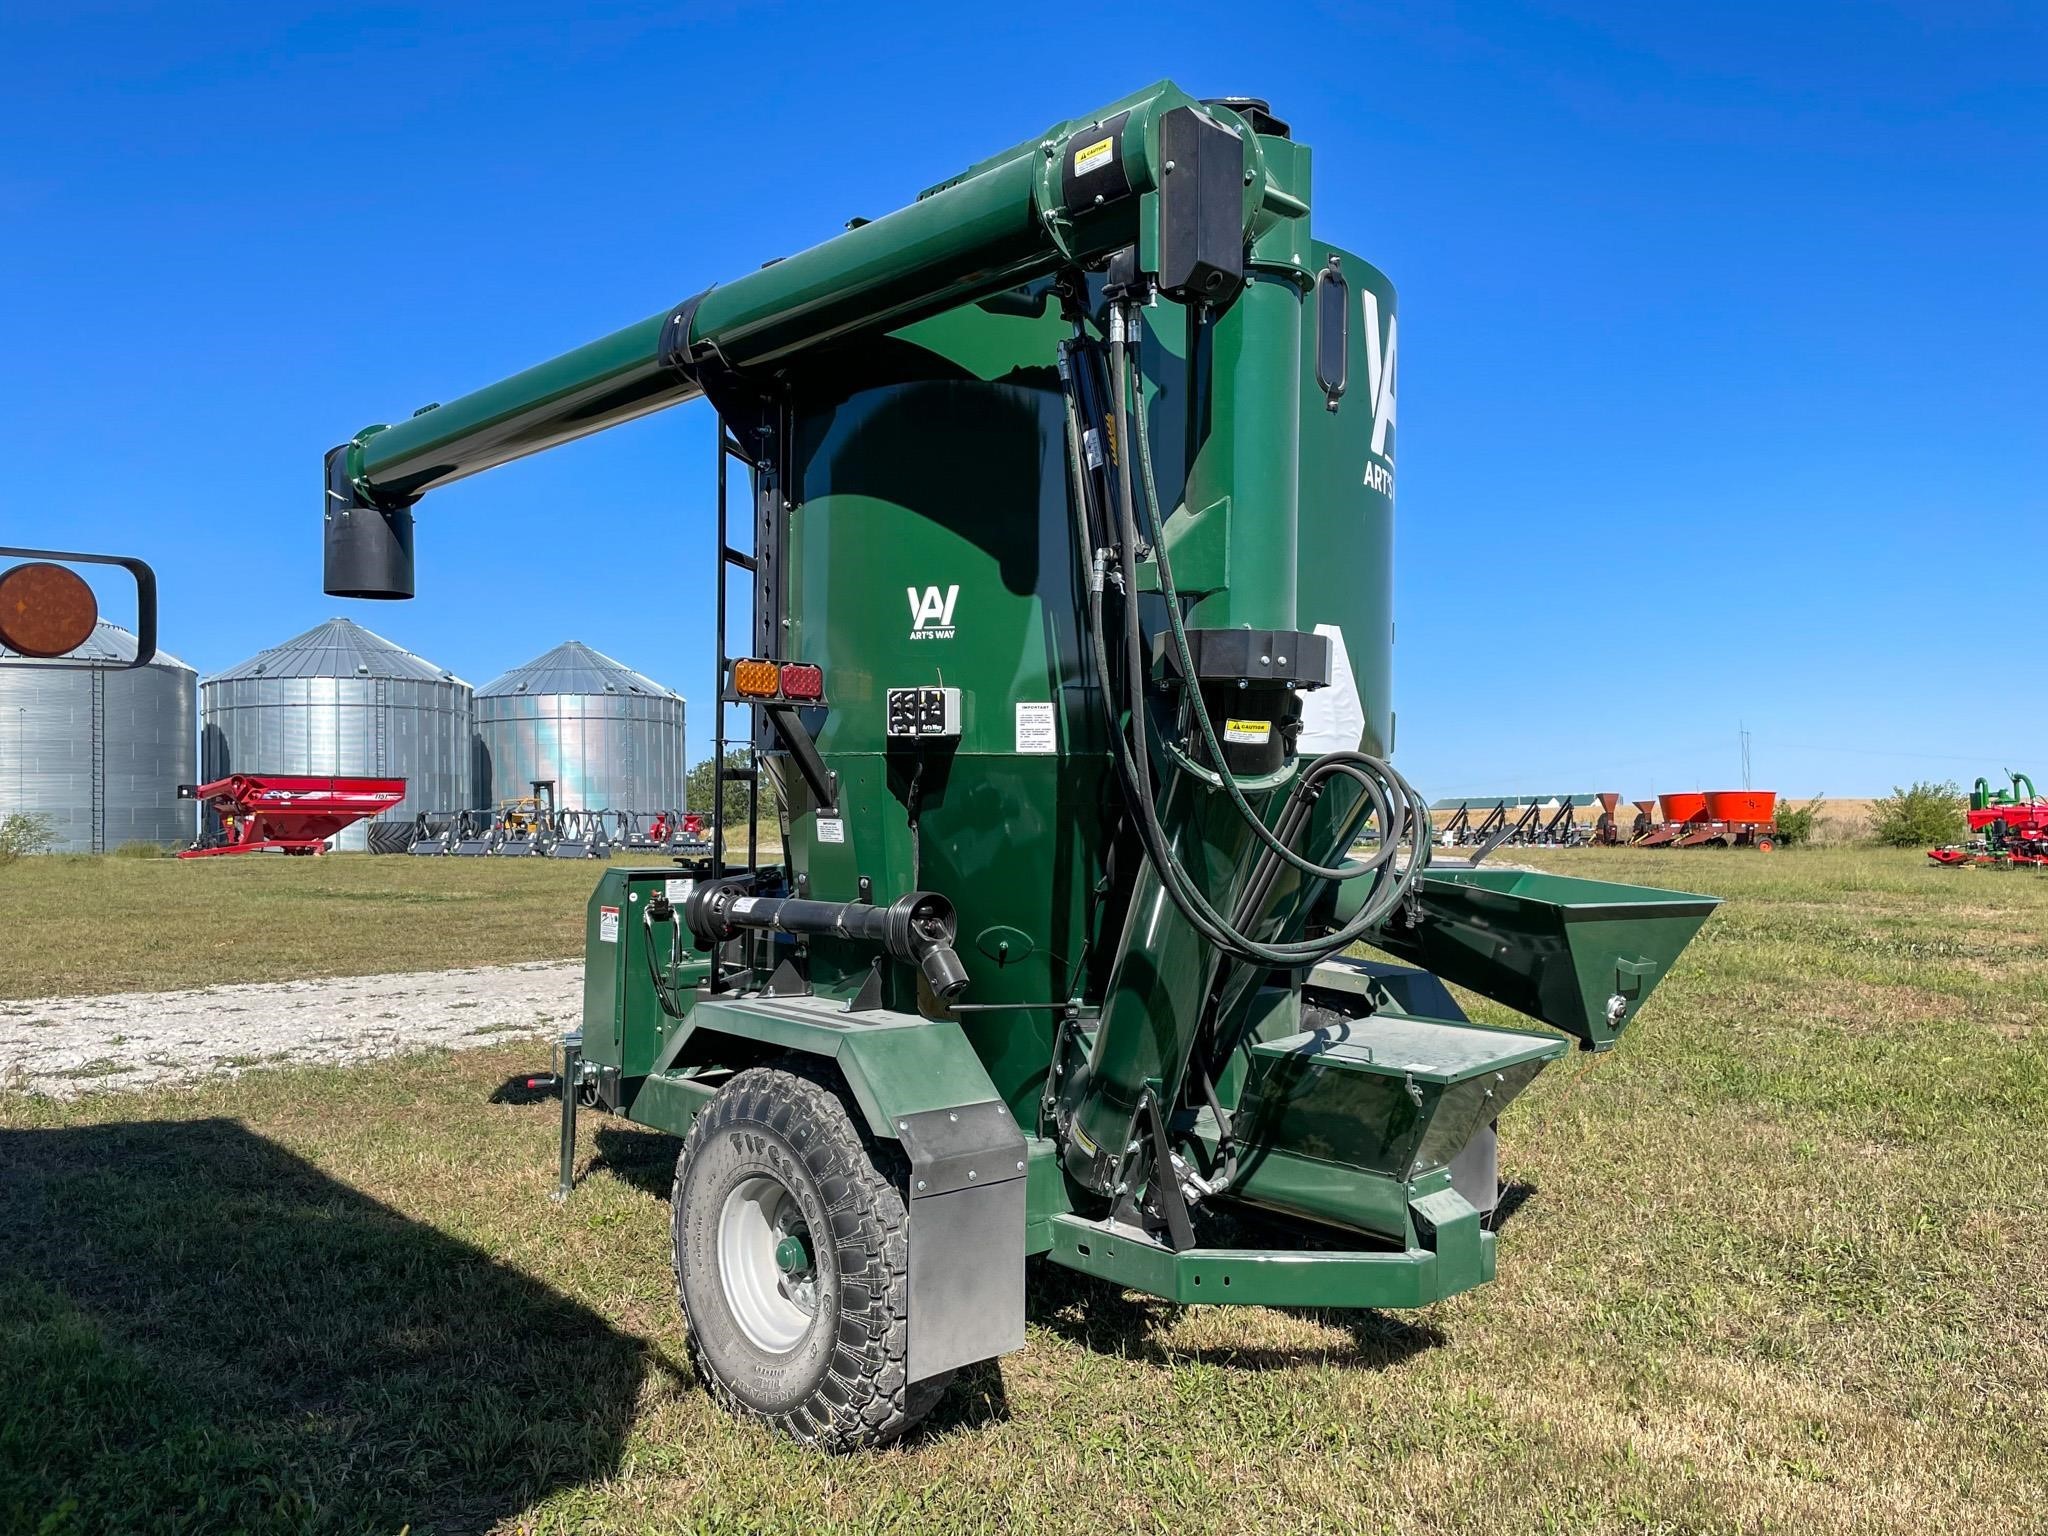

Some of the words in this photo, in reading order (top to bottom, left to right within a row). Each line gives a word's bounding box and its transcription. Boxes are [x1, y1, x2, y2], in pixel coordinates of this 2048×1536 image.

[1086, 144, 1107, 156] CAUTION
[1363, 460, 1393, 500] ART'S
[909, 630, 934, 640] ART'S
[934, 630, 955, 639] WAY
[729, 1132, 831, 1274] Firestone
